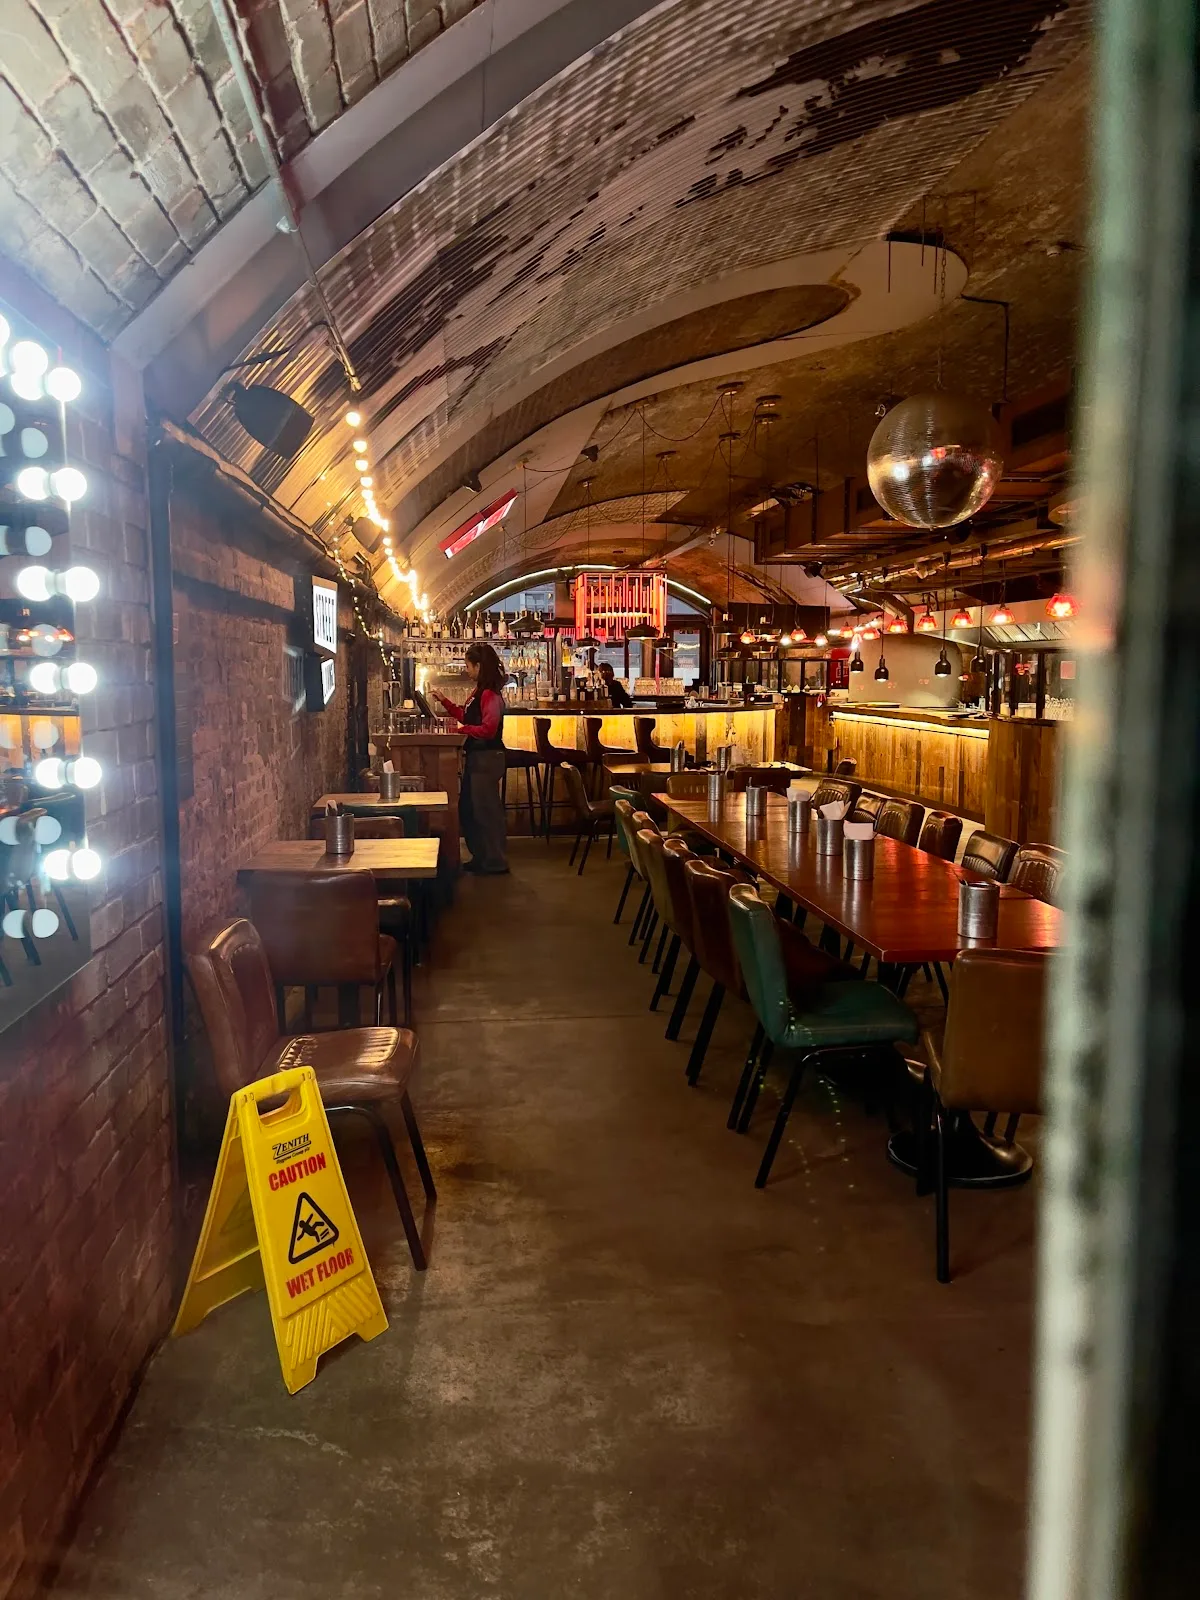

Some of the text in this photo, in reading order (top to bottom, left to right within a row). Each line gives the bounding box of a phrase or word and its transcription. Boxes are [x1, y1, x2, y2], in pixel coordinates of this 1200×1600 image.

[272, 1133, 311, 1160] ZENITH
[268, 1152, 326, 1191] CAUTION
[286, 1247, 354, 1299] WET FLOOR
